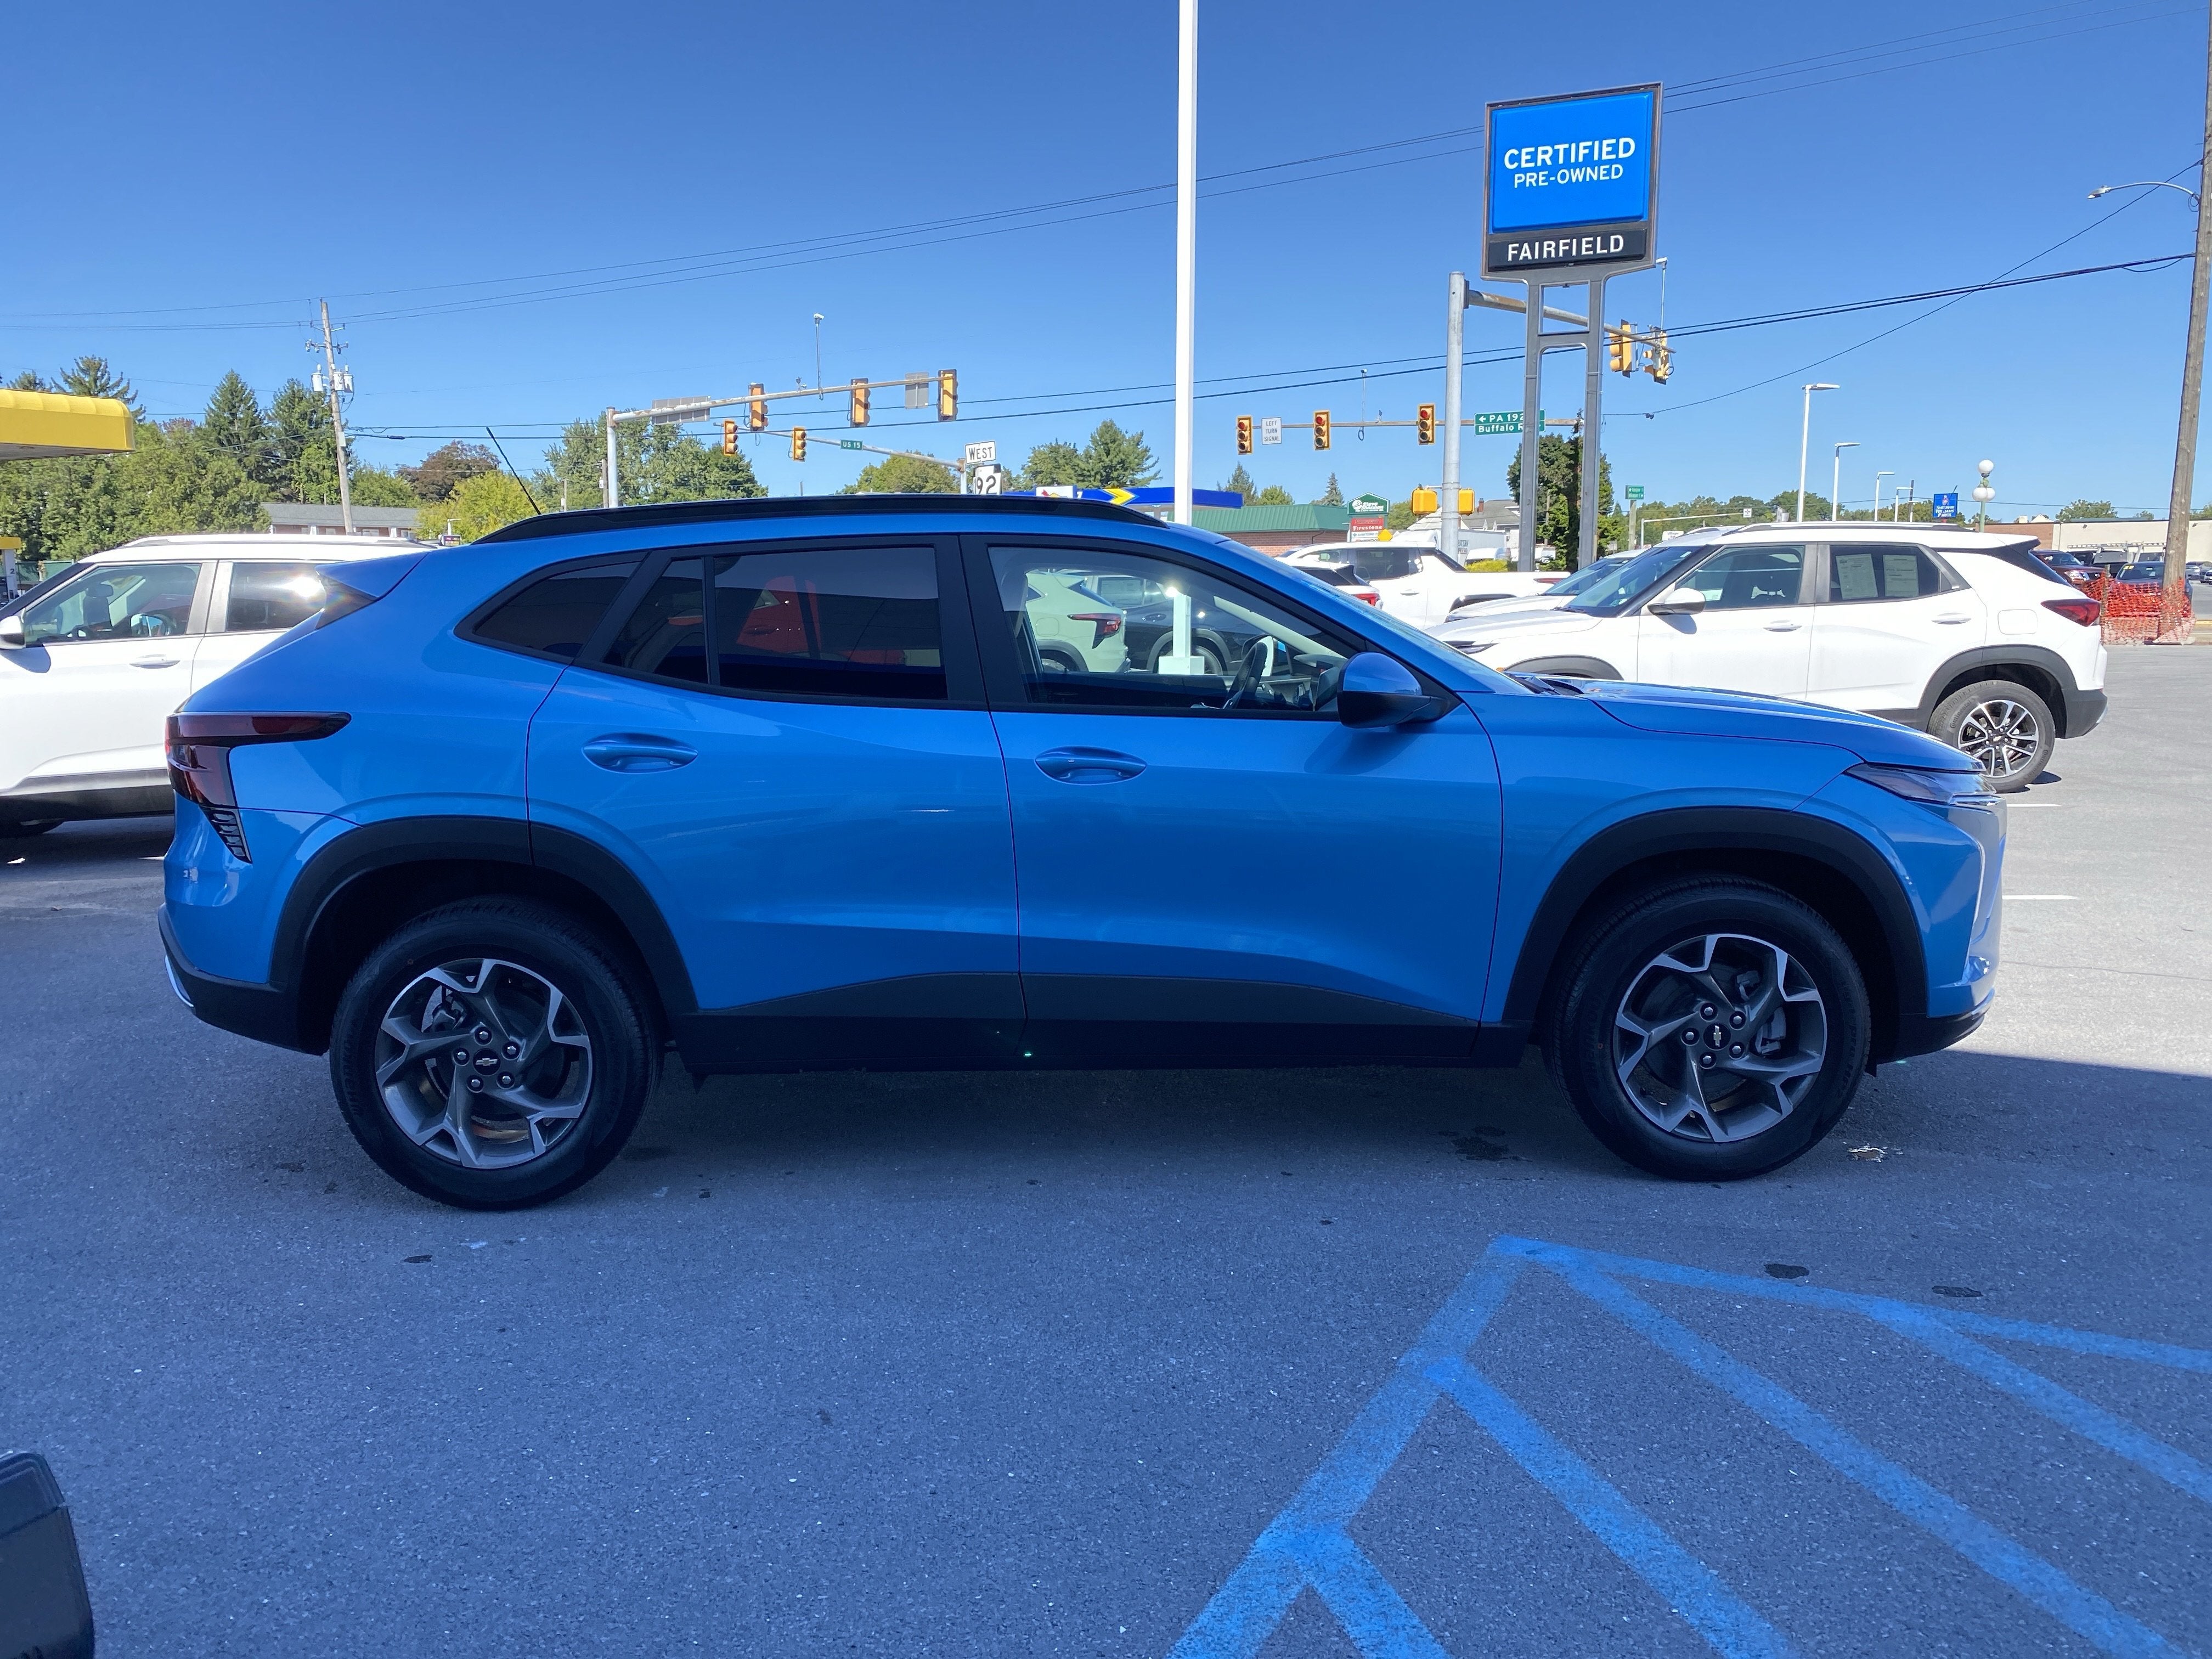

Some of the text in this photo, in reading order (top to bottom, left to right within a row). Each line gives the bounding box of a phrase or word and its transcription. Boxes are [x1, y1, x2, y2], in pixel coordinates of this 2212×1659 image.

[1504, 137, 1635, 170] CERTIFIED
[1514, 164, 1623, 189] PRE-OWNED
[1507, 235, 1624, 262] FAIRFIELD
[1489, 413, 1523, 422] PA 192
[1479, 424, 1514, 433] Buffalo
[968, 447, 992, 460] WEST
